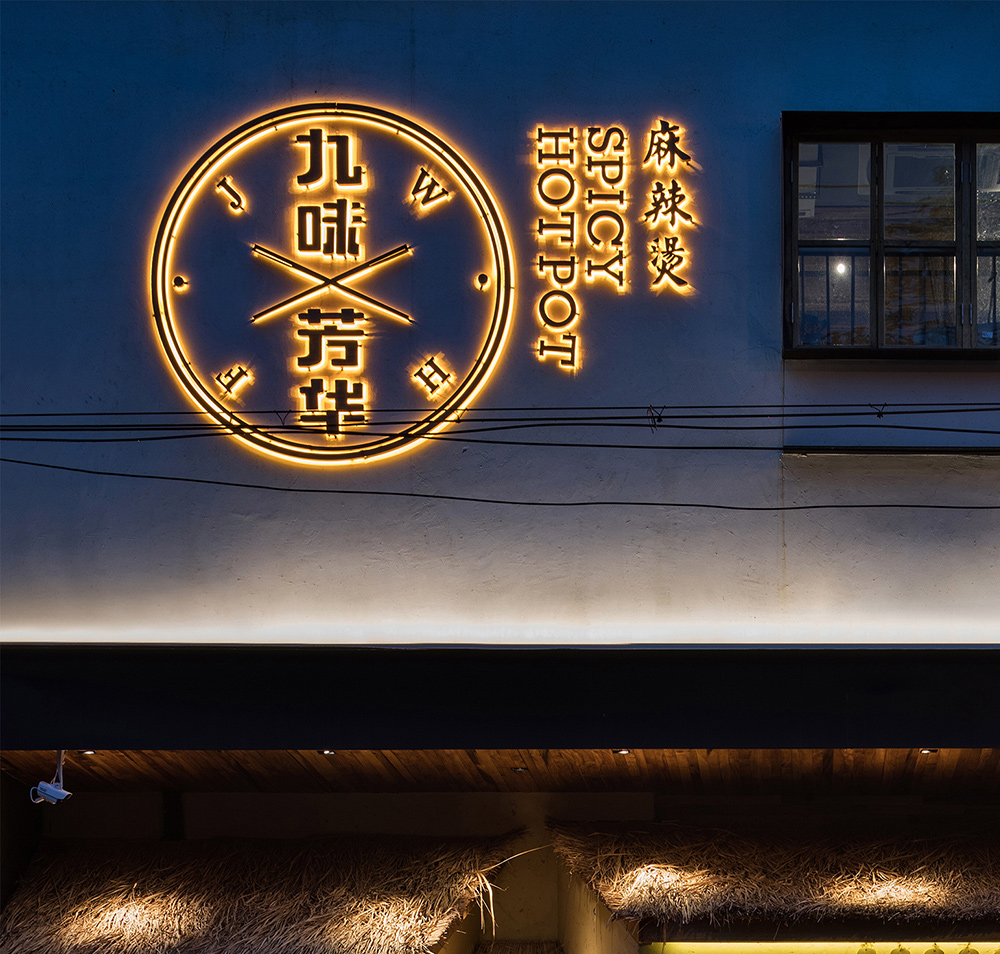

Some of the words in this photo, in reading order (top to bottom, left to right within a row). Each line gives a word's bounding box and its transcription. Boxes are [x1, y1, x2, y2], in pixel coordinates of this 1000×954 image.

[216, 175, 245, 212] J
[410, 167, 450, 208] W
[537, 127, 576, 245] HOT
[587, 127, 625, 287] SPICY
[537, 256, 580, 367] POT
[413, 356, 450, 394] H
